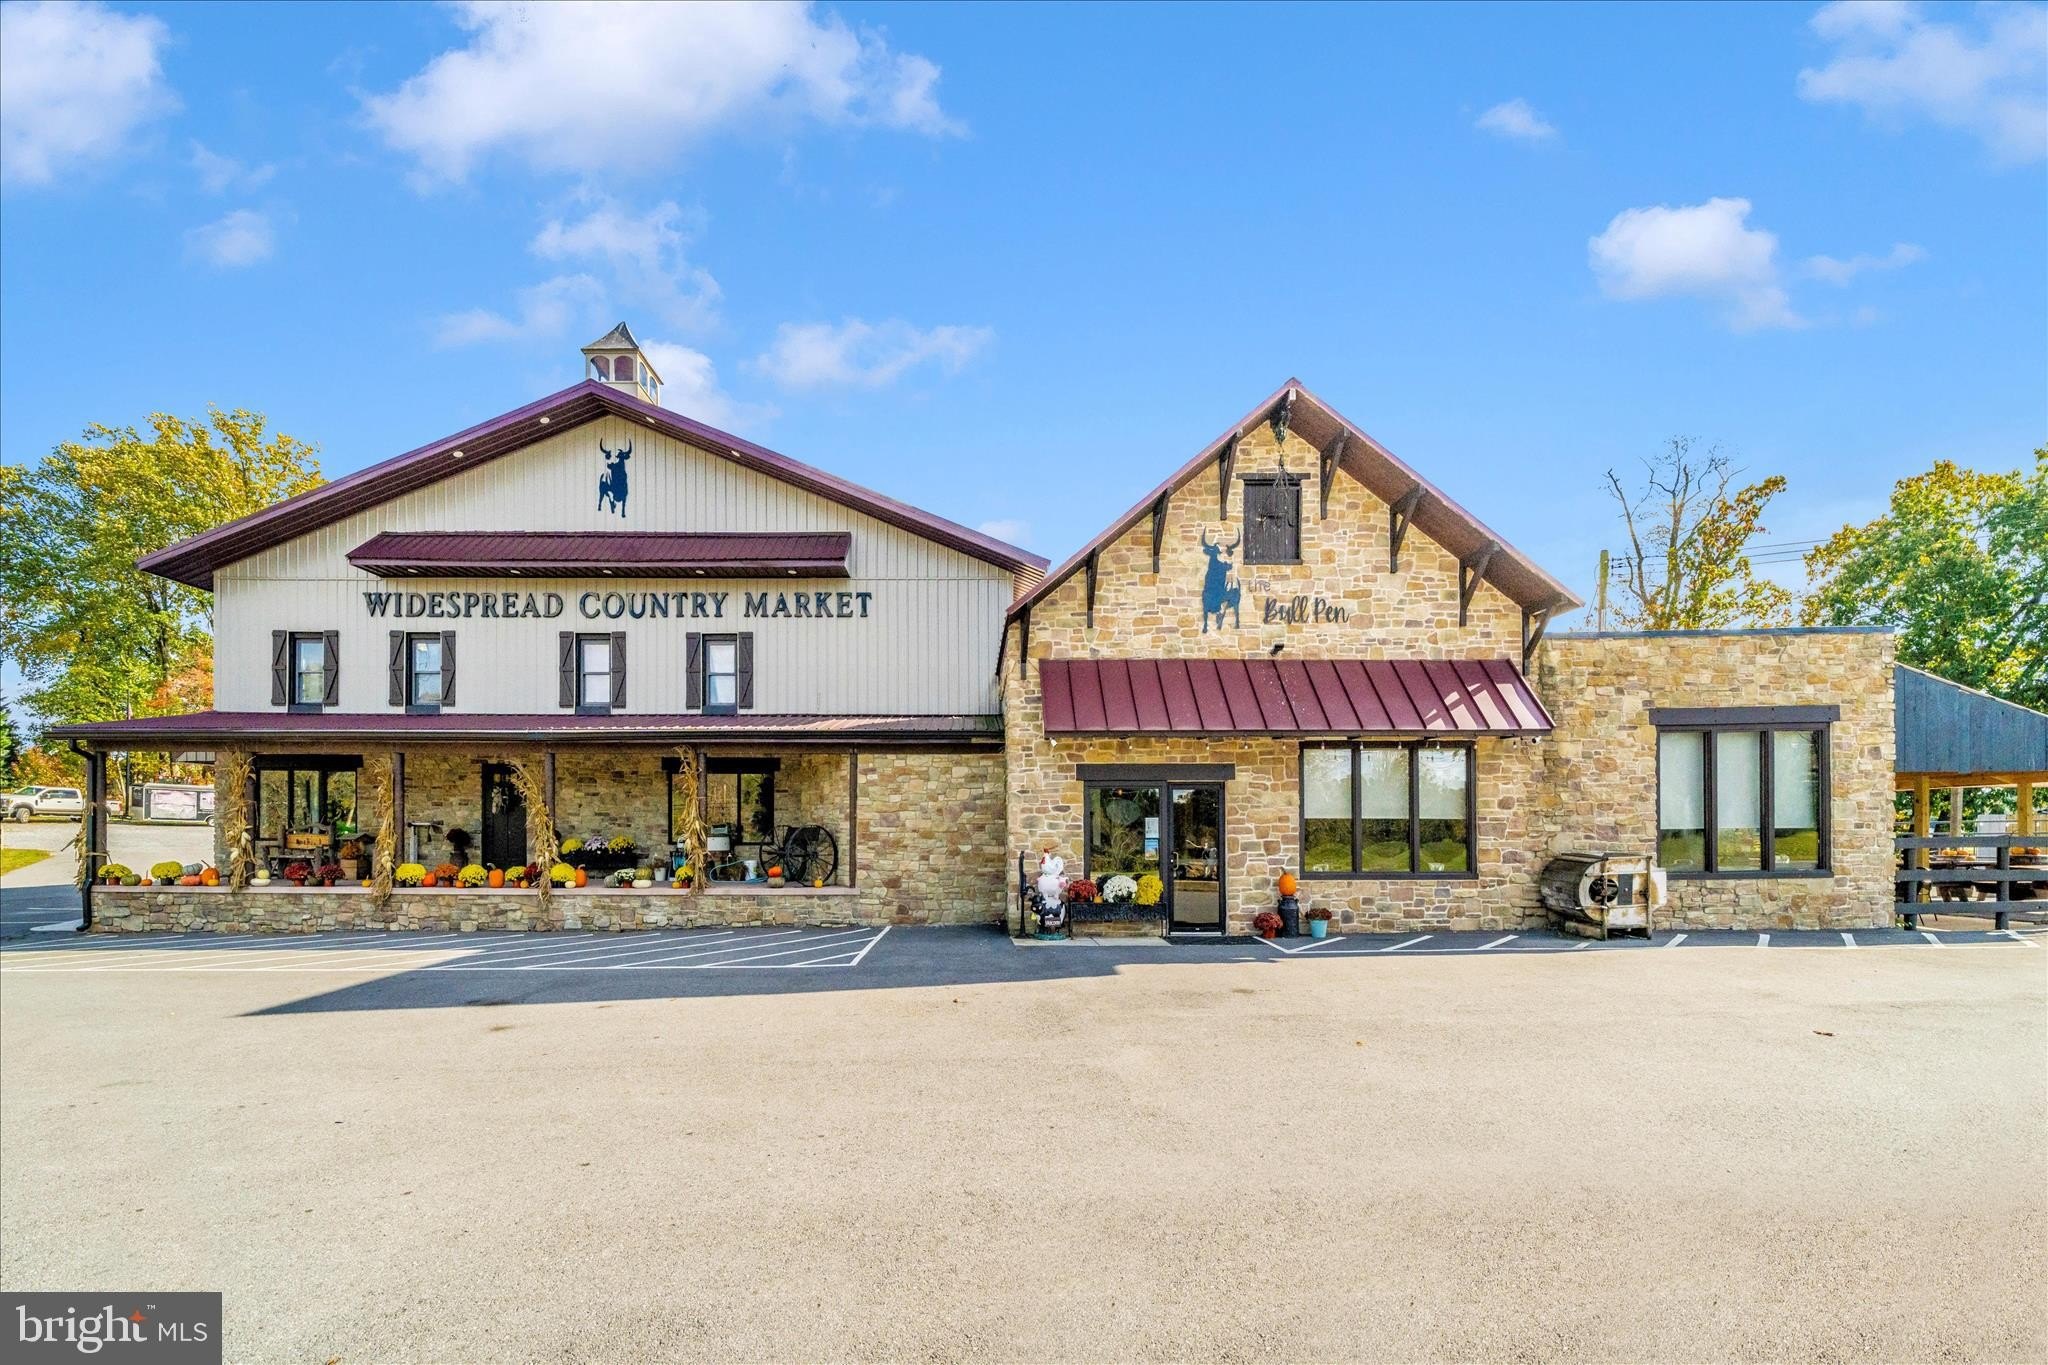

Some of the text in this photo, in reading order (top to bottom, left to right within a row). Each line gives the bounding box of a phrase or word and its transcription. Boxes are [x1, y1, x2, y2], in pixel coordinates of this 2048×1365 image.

[362, 591, 873, 619] WIDESPREAD COUNTRY MARKET
[1263, 595, 1350, 625] Bull Pen
